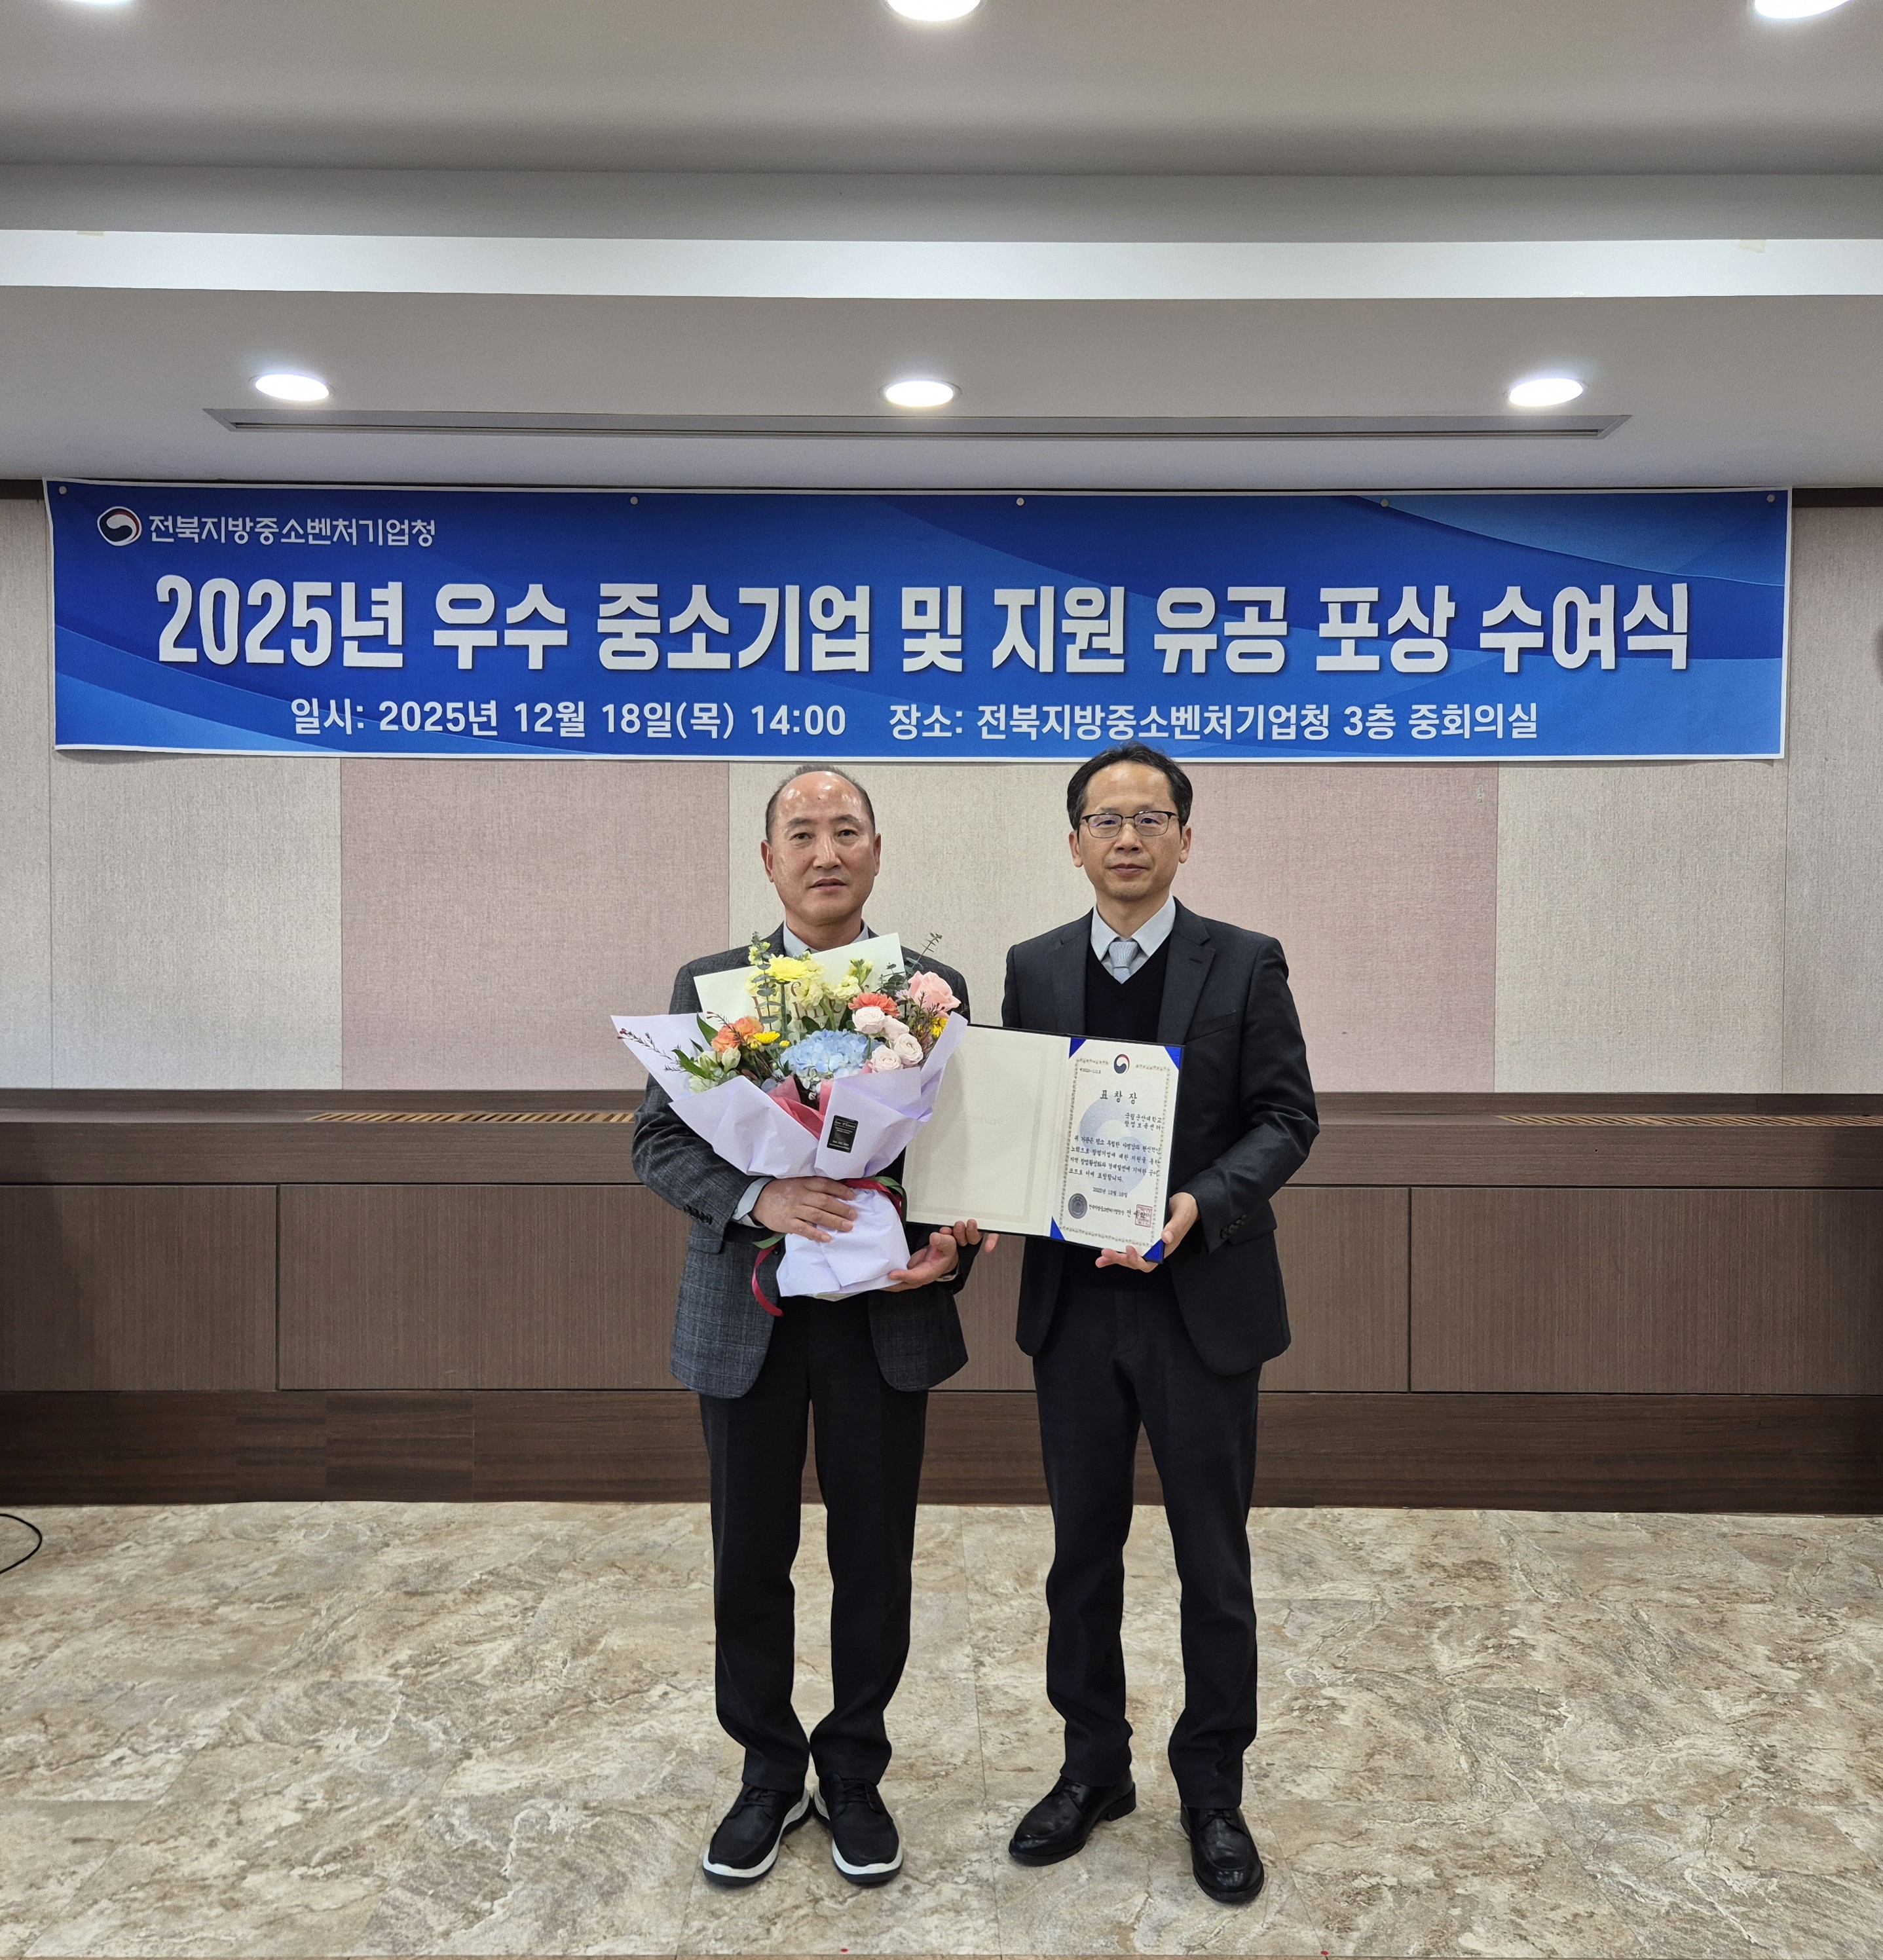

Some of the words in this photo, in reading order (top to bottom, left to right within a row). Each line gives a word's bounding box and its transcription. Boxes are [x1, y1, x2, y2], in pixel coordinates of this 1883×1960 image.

[150, 517, 434, 546] 전북지방중소벤처기업청
[157, 575, 403, 667] 2025년
[434, 584, 567, 669] 우수
[598, 583, 869, 671] 중소기업
[902, 586, 962, 671] 및
[993, 586, 1124, 672] 지원
[1155, 587, 1287, 673] 유공
[1316, 585, 1455, 672] 포상
[1480, 583, 1687, 672] 수여식
[291, 699, 364, 734] 일시:
[379, 701, 497, 735] 2025년
[515, 701, 585, 737] 12월
[603, 702, 733, 739] 18일(목)
[752, 705, 845, 735] 14:00
[890, 705, 962, 739] 장소:
[977, 705, 1328, 740] 전북지방중소벤처기업청
[1344, 705, 1396, 739] 3층
[1409, 703, 1537, 739] 중회의실
